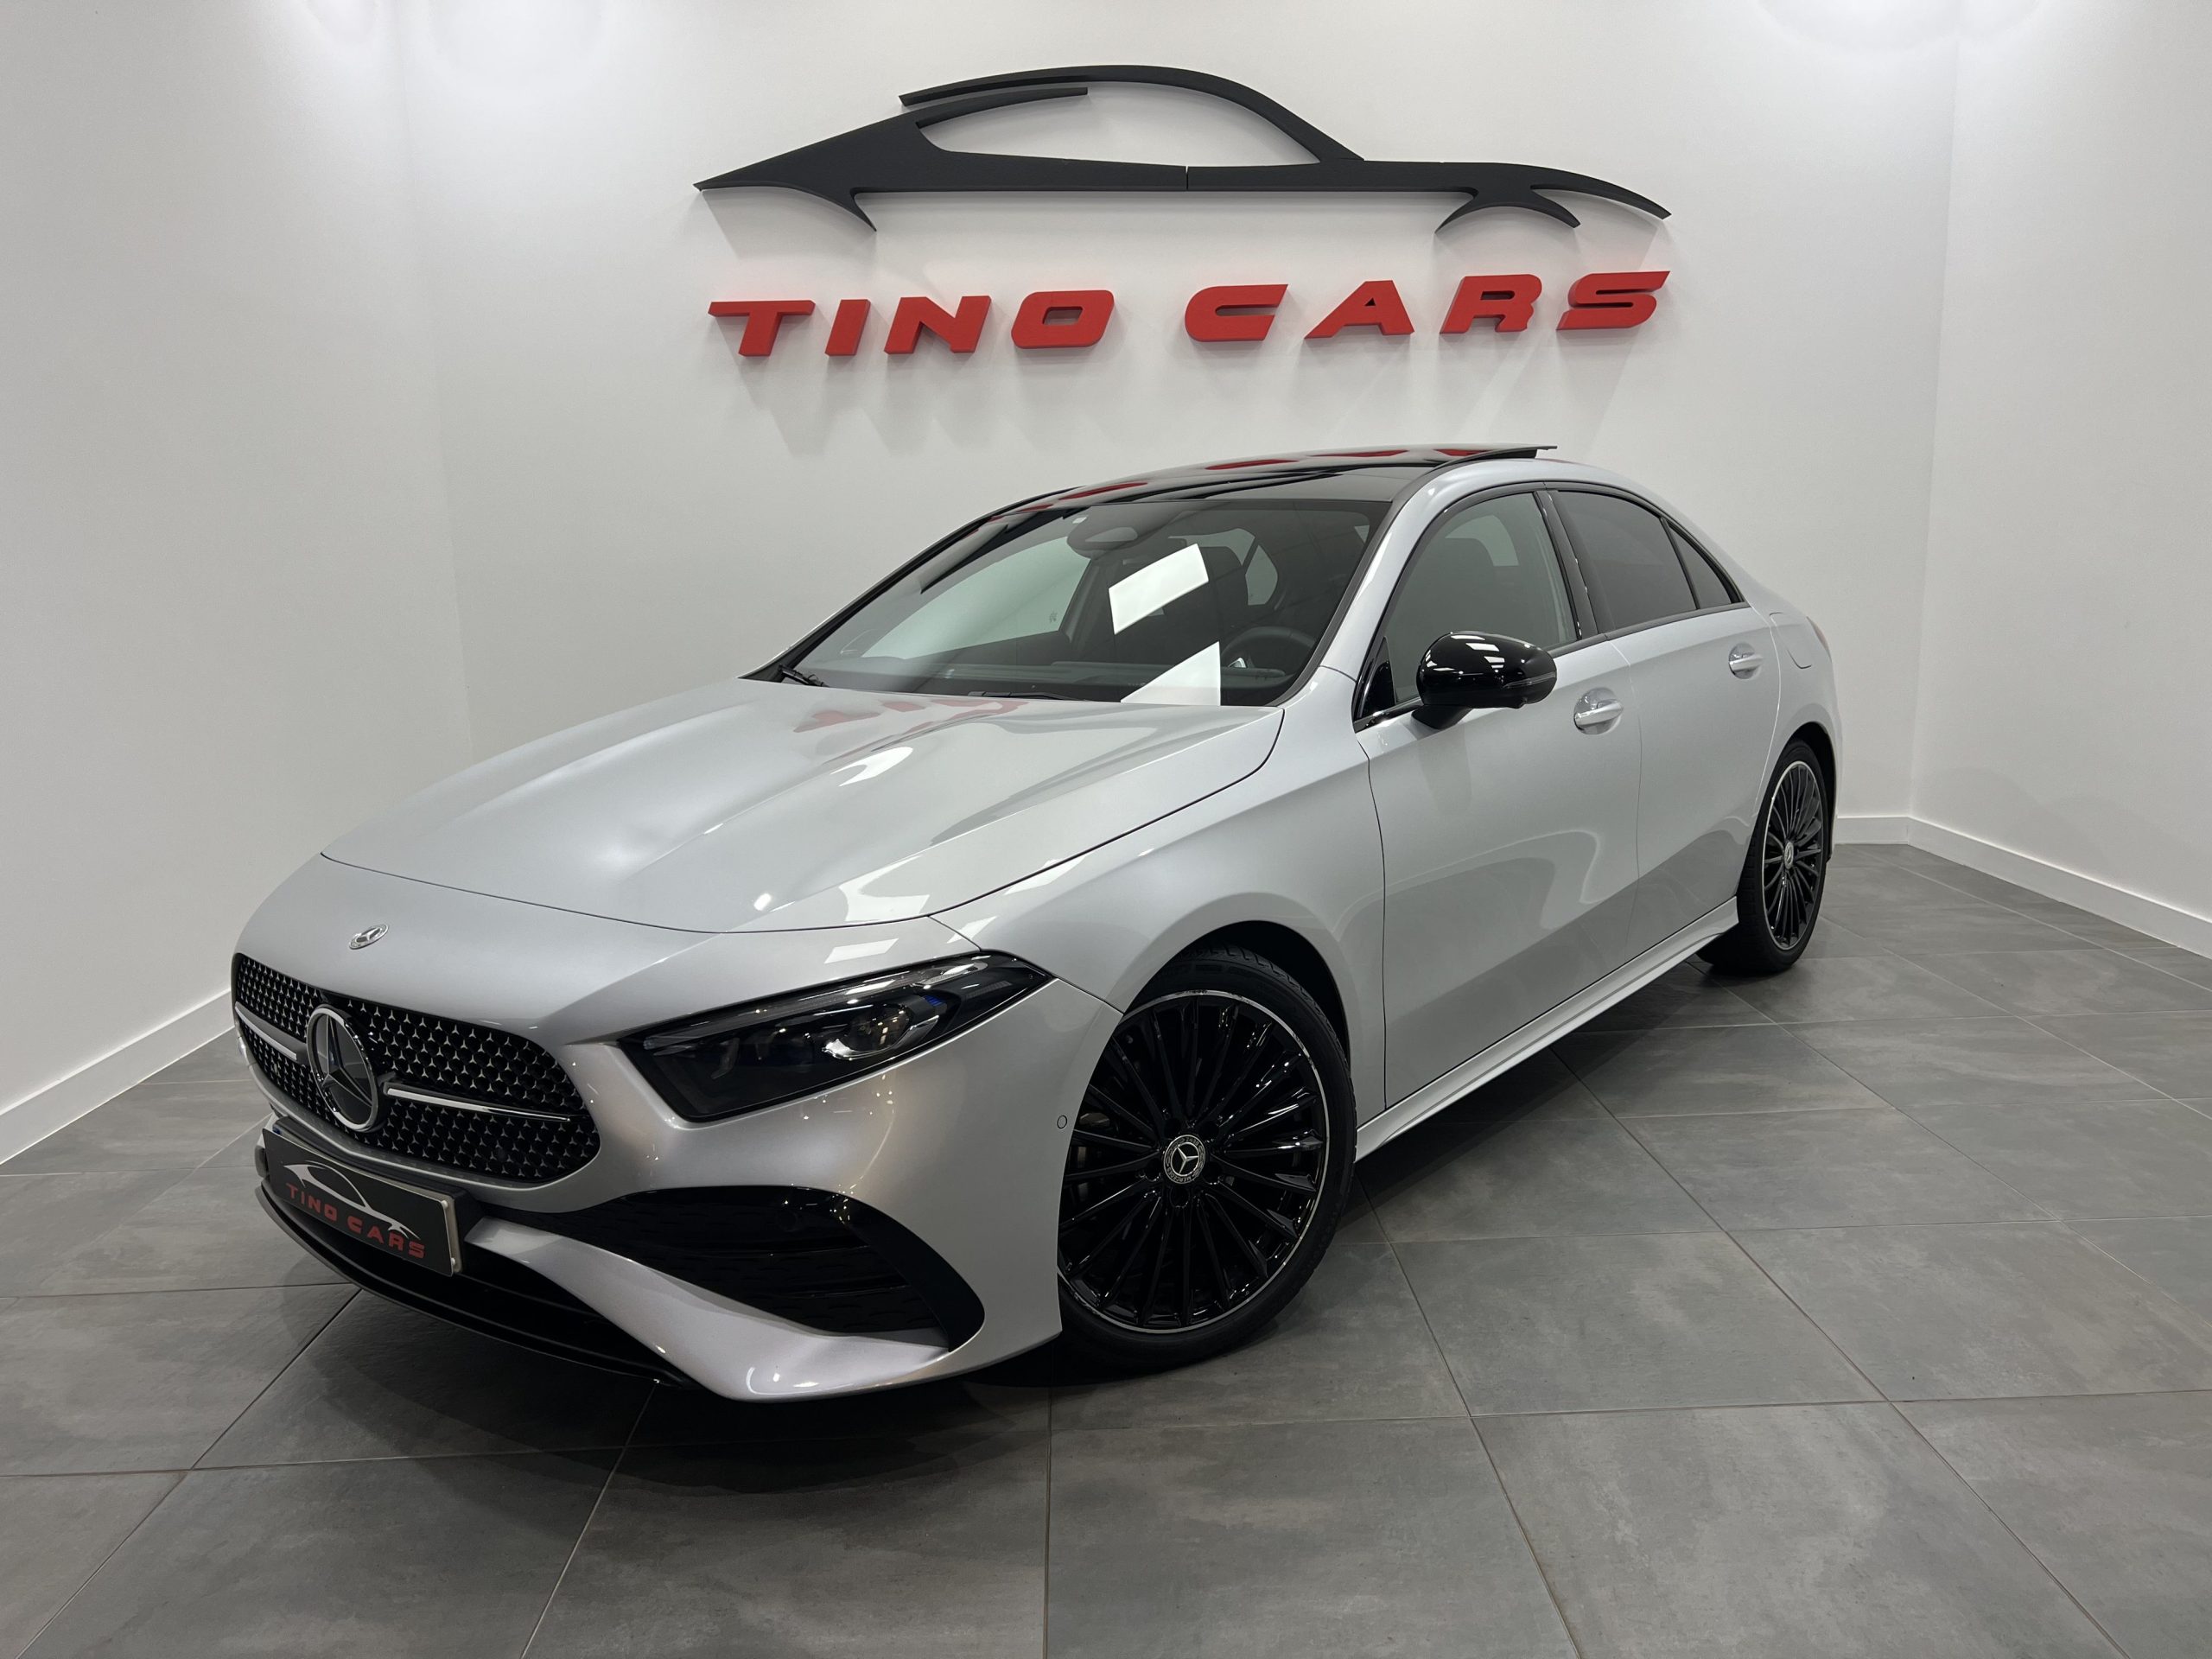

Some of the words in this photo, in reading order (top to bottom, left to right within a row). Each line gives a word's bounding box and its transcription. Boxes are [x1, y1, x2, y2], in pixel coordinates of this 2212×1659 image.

[709, 289, 1116, 357] TINO
[1184, 270, 1670, 342] CARS
[285, 1182, 338, 1222] TINO
[346, 1215, 425, 1259] CARS
